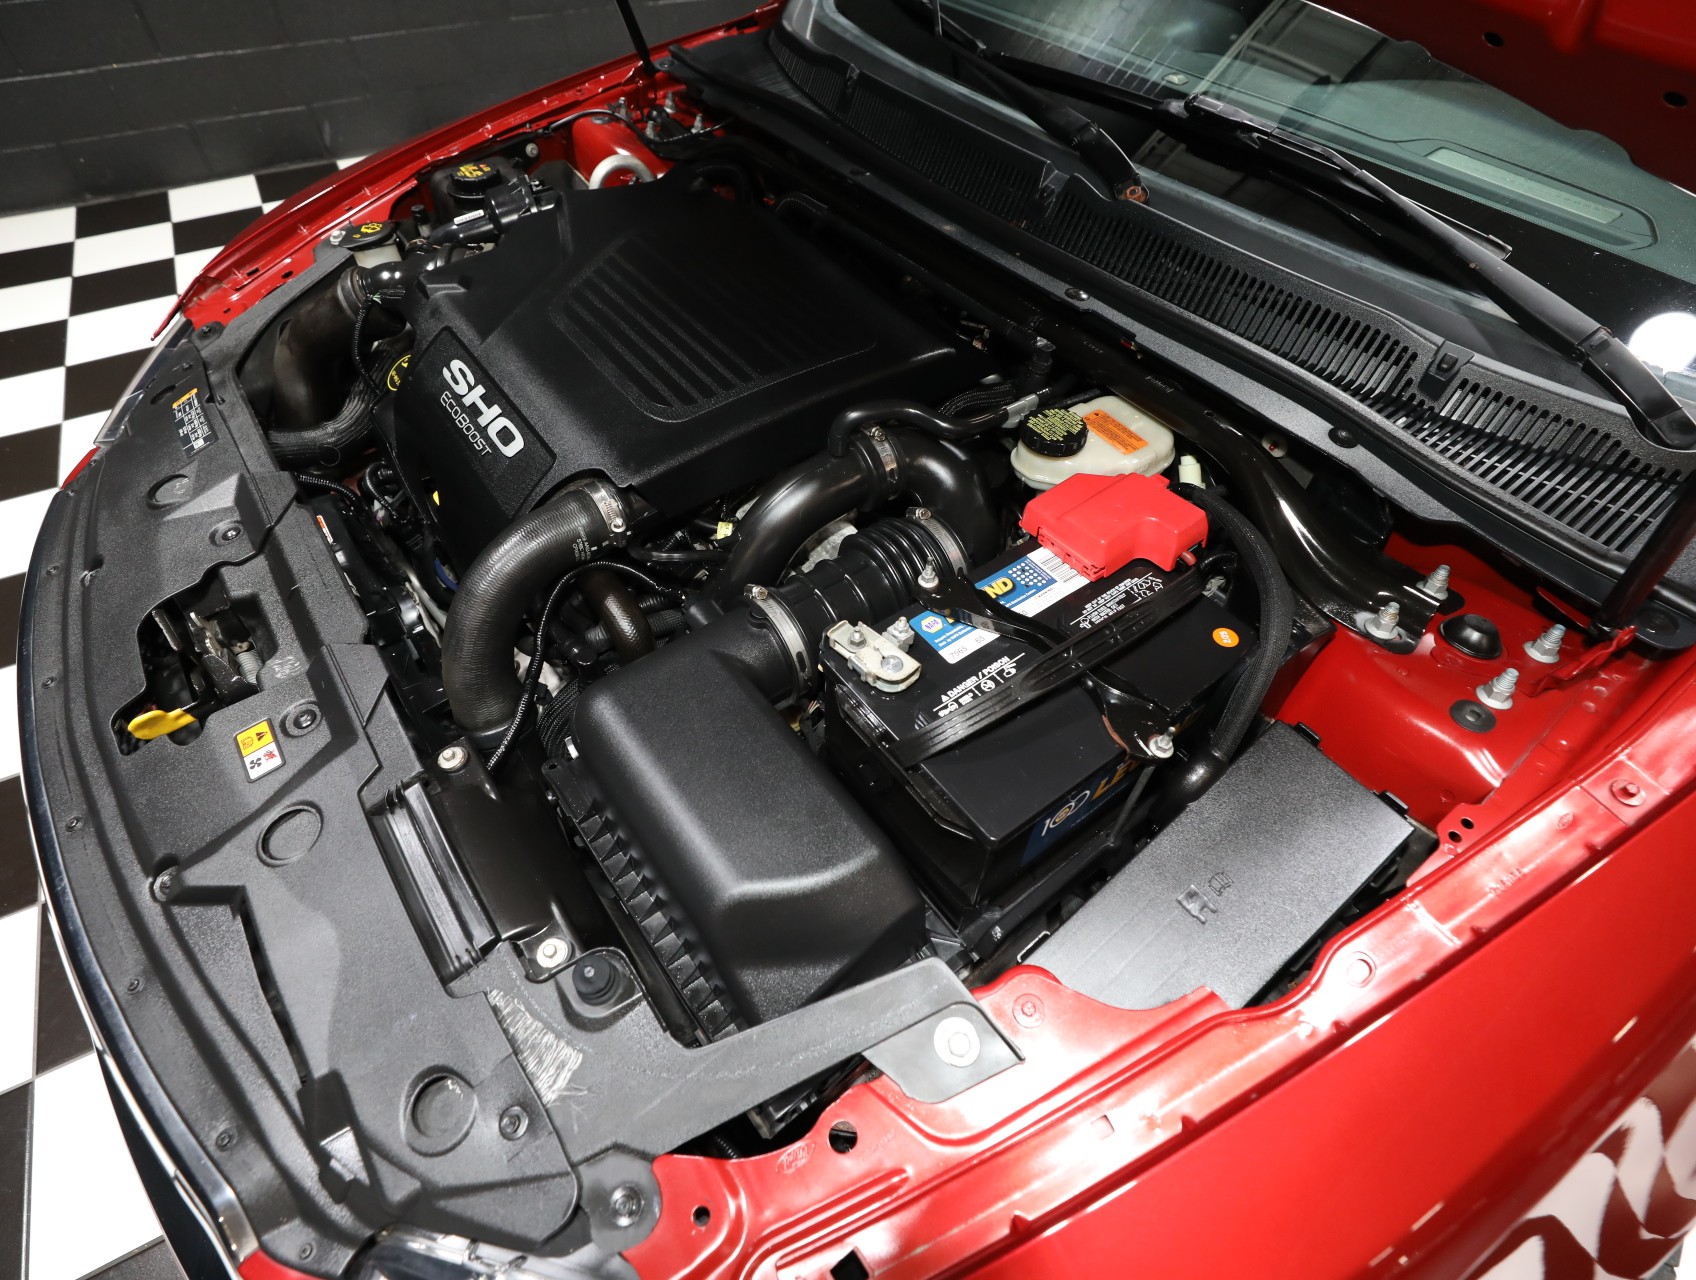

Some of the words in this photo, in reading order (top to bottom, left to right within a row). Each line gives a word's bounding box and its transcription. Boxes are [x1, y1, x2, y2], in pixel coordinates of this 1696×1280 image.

[440, 391, 492, 455] ECOBOOST
[443, 360, 524, 457] SHO
[982, 577, 1014, 599] ND
[924, 618, 940, 630] NAPA
[949, 645, 968, 659] 7565
[947, 675, 980, 698] DANGER
[982, 655, 1011, 676] POISON
